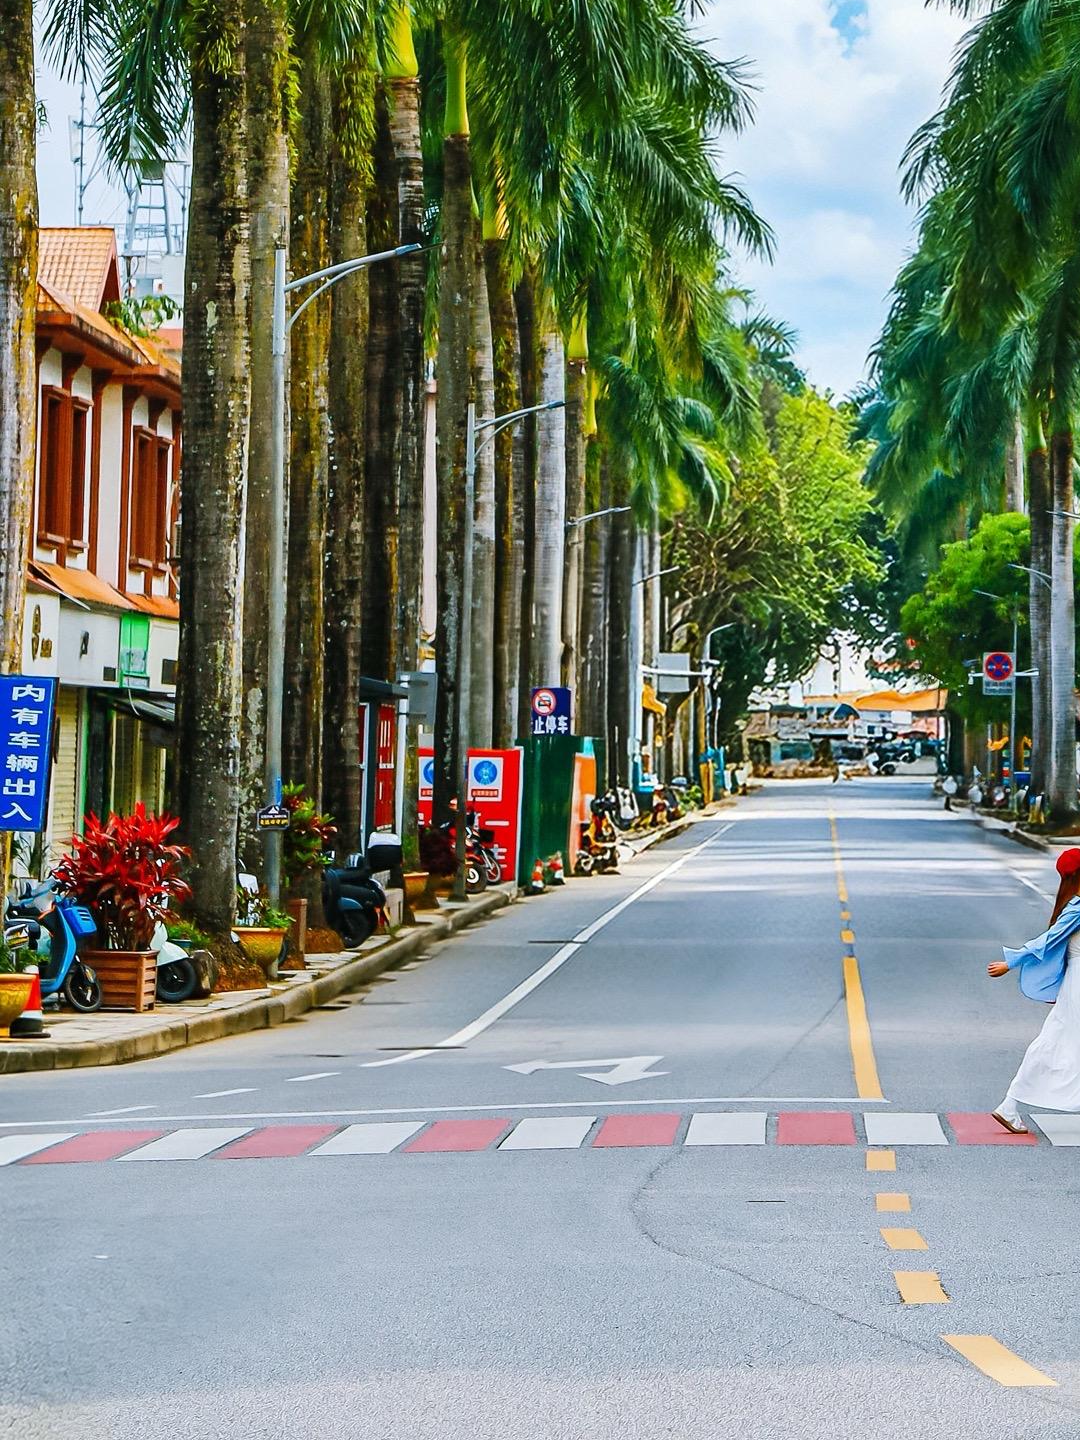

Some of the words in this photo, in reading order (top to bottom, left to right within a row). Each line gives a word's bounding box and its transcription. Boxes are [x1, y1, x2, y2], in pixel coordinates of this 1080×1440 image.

[2, 684, 46, 822] 内有车辆出入
[531, 715, 569, 735] 止停车
